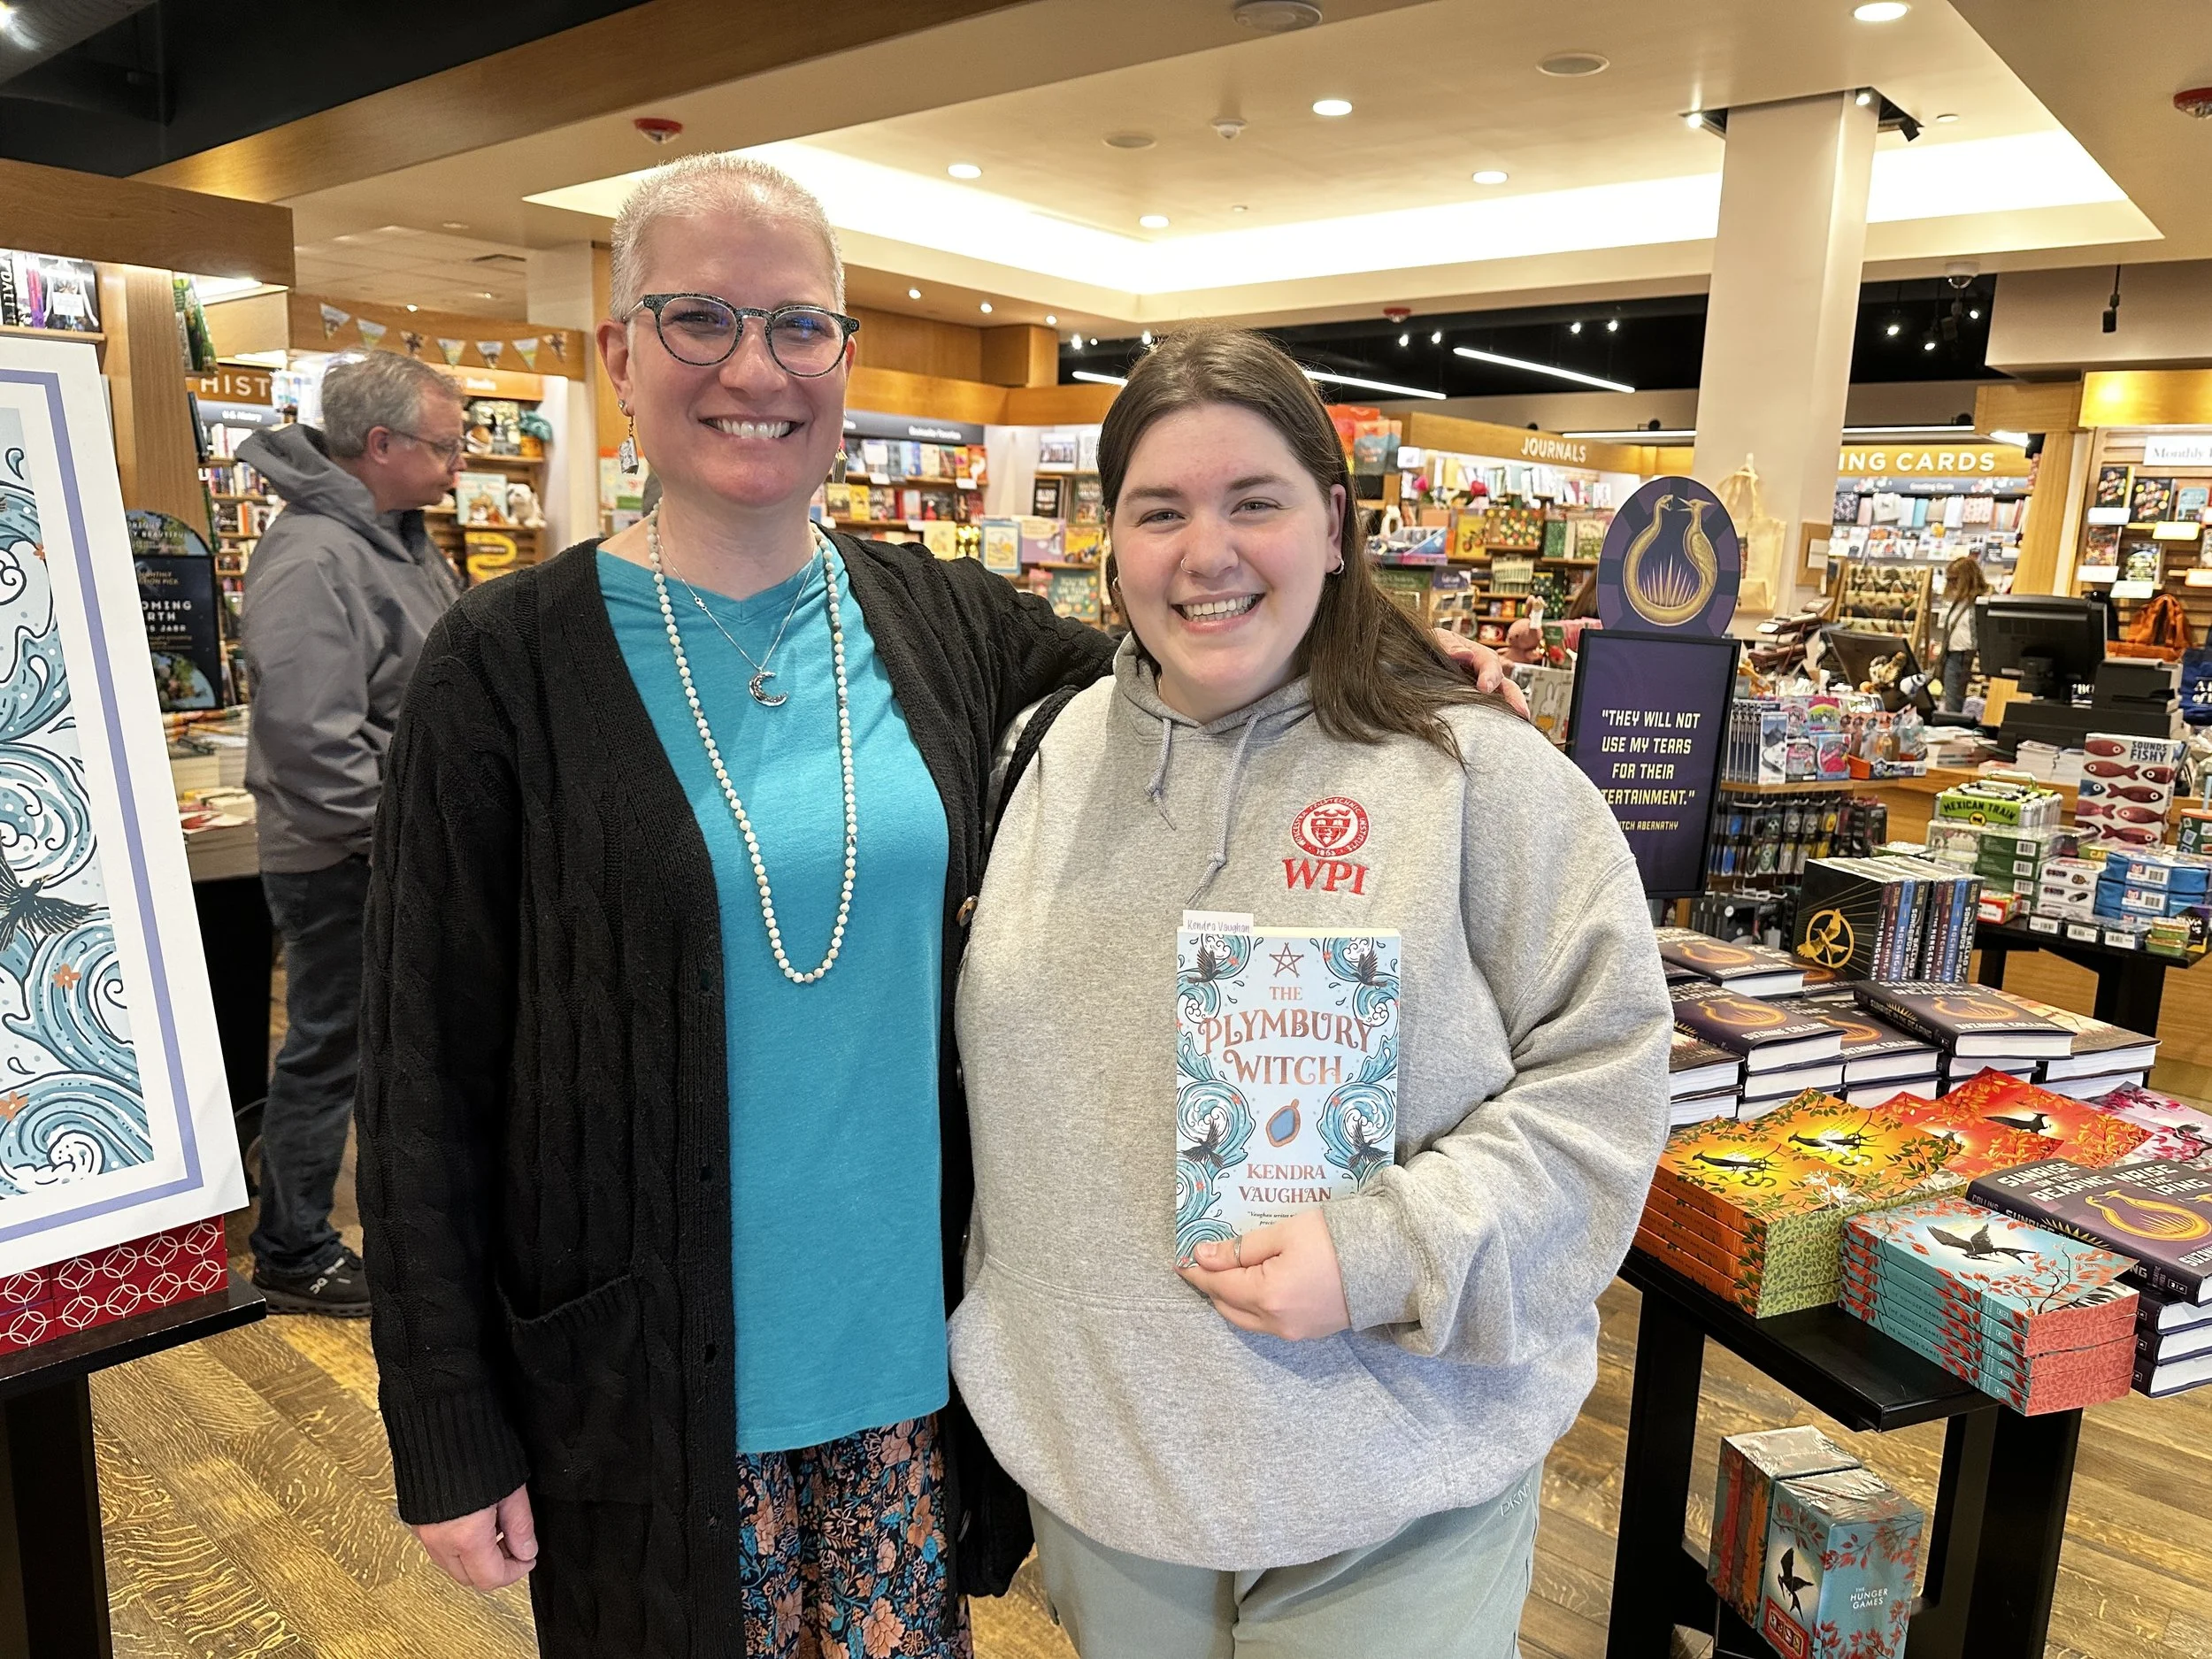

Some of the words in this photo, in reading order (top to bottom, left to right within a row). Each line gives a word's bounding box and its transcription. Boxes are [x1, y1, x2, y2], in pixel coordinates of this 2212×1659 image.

[200, 374, 270, 397] HIST
[1521, 436, 1586, 463] JOURNALS
[2153, 447, 2205, 459] Monthly
[1838, 452, 1886, 472] ING
[1896, 452, 1995, 472] CARDS
[1601, 710, 1640, 726] "THEY
[1644, 710, 1671, 727] WILL
[1675, 712, 1701, 729] NOT
[1601, 736, 1626, 753] USE
[1630, 737, 1649, 753] MY
[1653, 738, 1692, 754] TEARS
[2131, 741, 2167, 751] SOUNDS
[2130, 749, 2167, 762] FISHY
[1611, 763, 1636, 779] FOR
[1640, 764, 1675, 780] THEIR
[1944, 800, 1985, 812] MEXICAN
[1987, 803, 2016, 821] TRAIN
[1637, 821, 1678, 830] ABERNATHY
[1282, 856, 1370, 895] WPI
[1187, 920, 1216, 931] Kendra
[1218, 921, 1249, 933] Vaughan
[1873, 931, 1883, 965] HUNGER
[1883, 926, 1894, 969] CATCHING
[1909, 938, 1919, 969] BALLAD
[1927, 929, 1937, 964] HUNGER
[1936, 924, 1947, 967] CATCHING
[1963, 935, 1972, 966] BALLAD
[1269, 986, 1303, 1001] THE
[1198, 1008, 1375, 1055] PLYMBURY
[1223, 1049, 1342, 1086] WITCH
[1247, 1163, 1327, 1180] KENDRA
[1997, 1162, 2079, 1188] SUNRISE
[2035, 1179, 2055, 1188] ON
[2054, 1173, 2078, 1182] THE
[2142, 1176, 2172, 1186] THE
[1239, 1186, 1333, 1203] VAUGHAN
[2029, 1175, 2116, 1202] REAPING
[1971, 1194, 1999, 1210] COLLINS
[1888, 1306, 1898, 1316] THE
[1900, 1312, 1922, 1329] HUNGER
[1924, 1326, 1942, 1340] GAMES
[1924, 1309, 1943, 1322] GAMES
[1886, 1324, 1896, 1333] THE
[1898, 1330, 1919, 1346] HUNGER
[1921, 1345, 1940, 1359] GAMES
[1500, 1478, 1532, 1517] DKNY
[1850, 1588, 1888, 1601] HUNGER
[1852, 1597, 1884, 1609] GAMES
